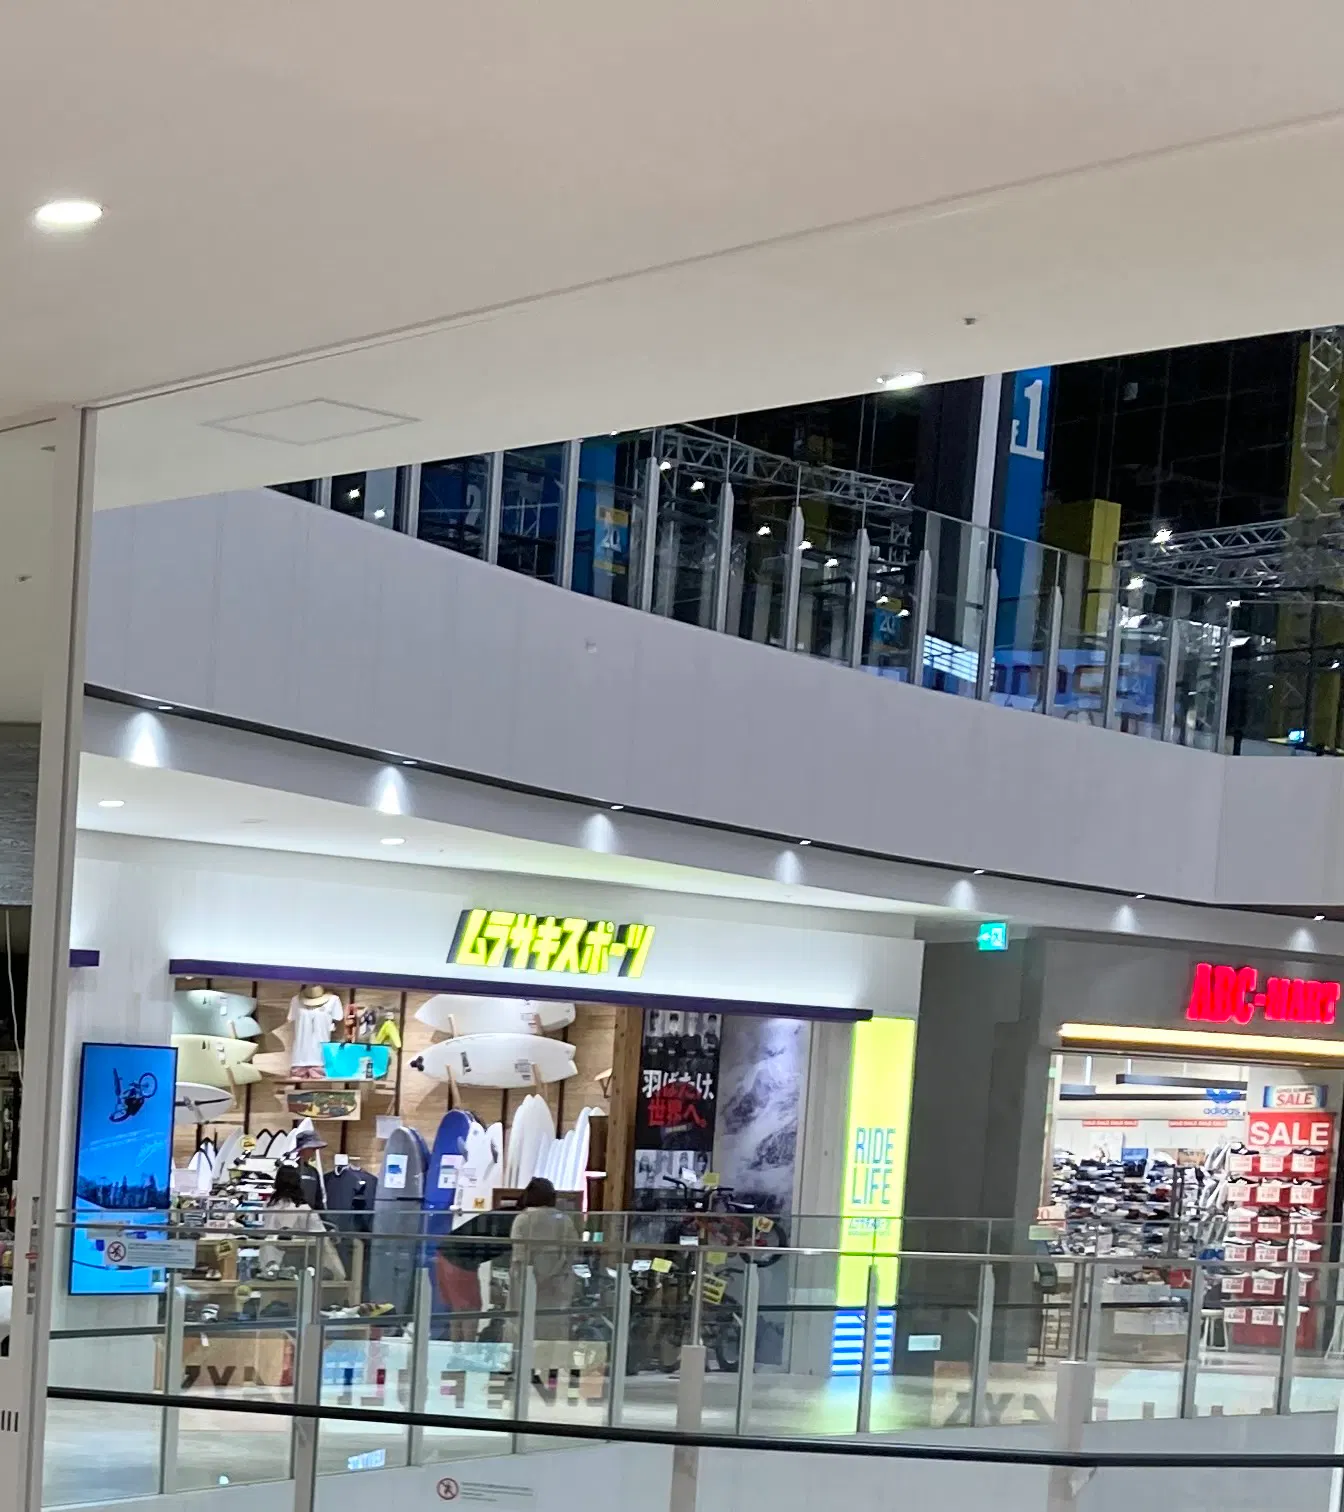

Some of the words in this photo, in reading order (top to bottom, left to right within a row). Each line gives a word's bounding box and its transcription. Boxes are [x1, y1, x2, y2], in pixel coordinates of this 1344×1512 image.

[446, 908, 656, 979] ムラサキスポーツ
[1185, 962, 1341, 1025] ABC-MART
[1203, 1106, 1241, 1116] adidas
[1276, 1092, 1314, 1106] SALE
[853, 1127, 896, 1164] RIDE
[1249, 1120, 1330, 1147] SALE
[851, 1167, 893, 1205] LIFE
